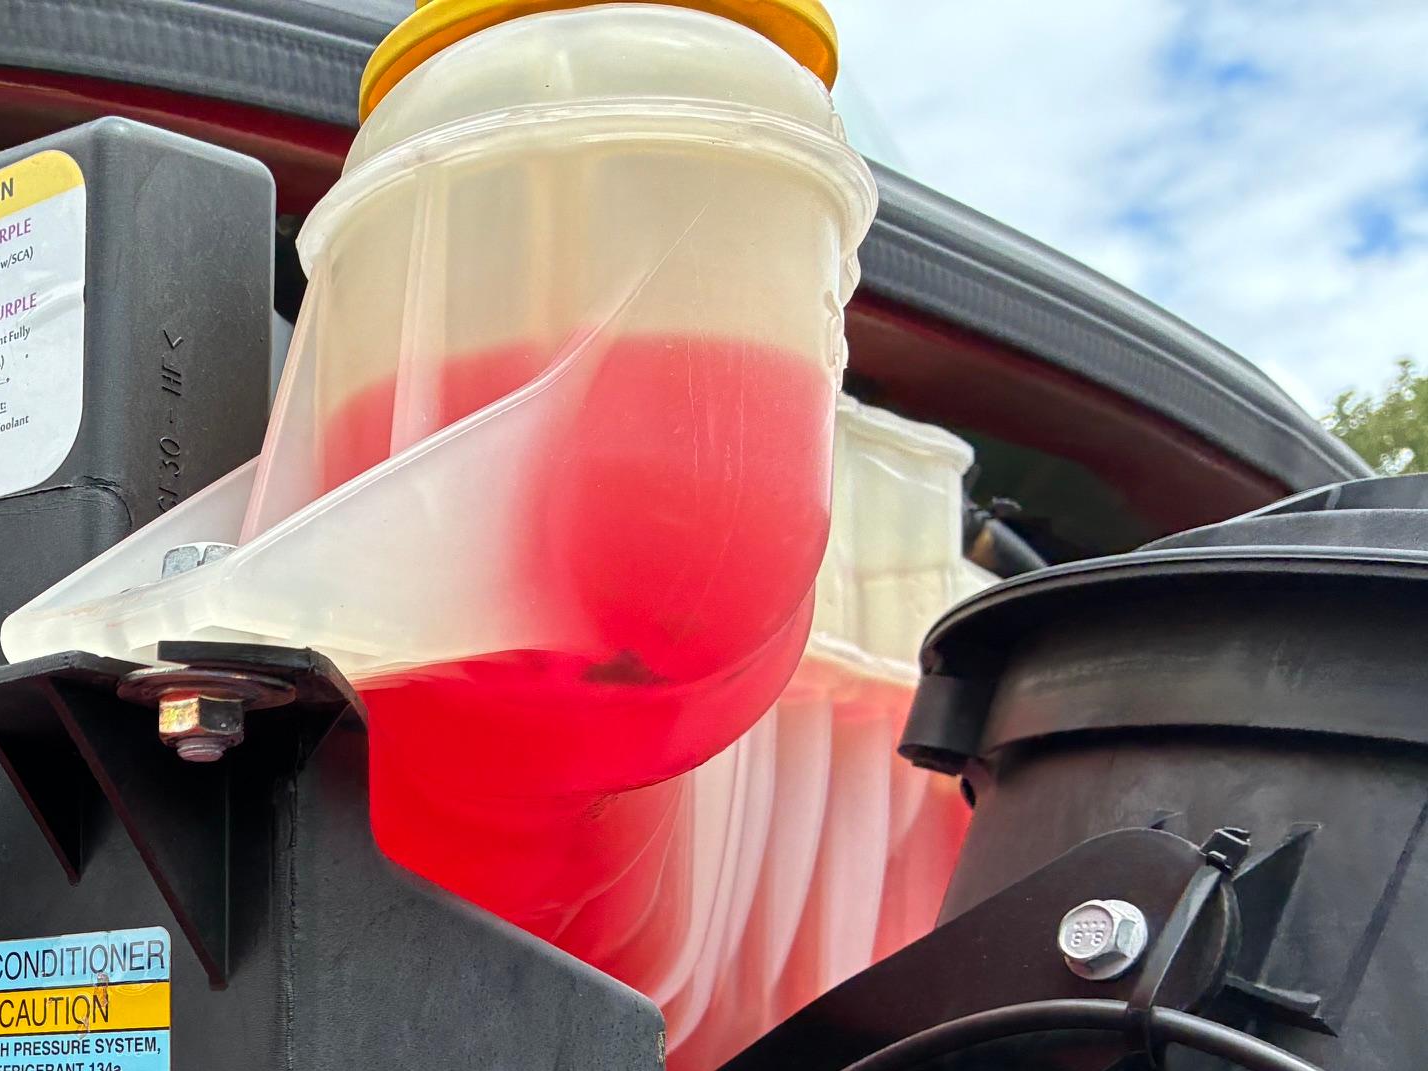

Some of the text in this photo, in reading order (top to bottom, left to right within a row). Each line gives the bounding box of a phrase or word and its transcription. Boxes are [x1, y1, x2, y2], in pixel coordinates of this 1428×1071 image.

[9, 326, 31, 345] Fully
[0, 995, 108, 1028] CAUTION
[14, 1039, 90, 1056] PRESSURE
[95, 1037, 161, 1054] SYSTEM,
